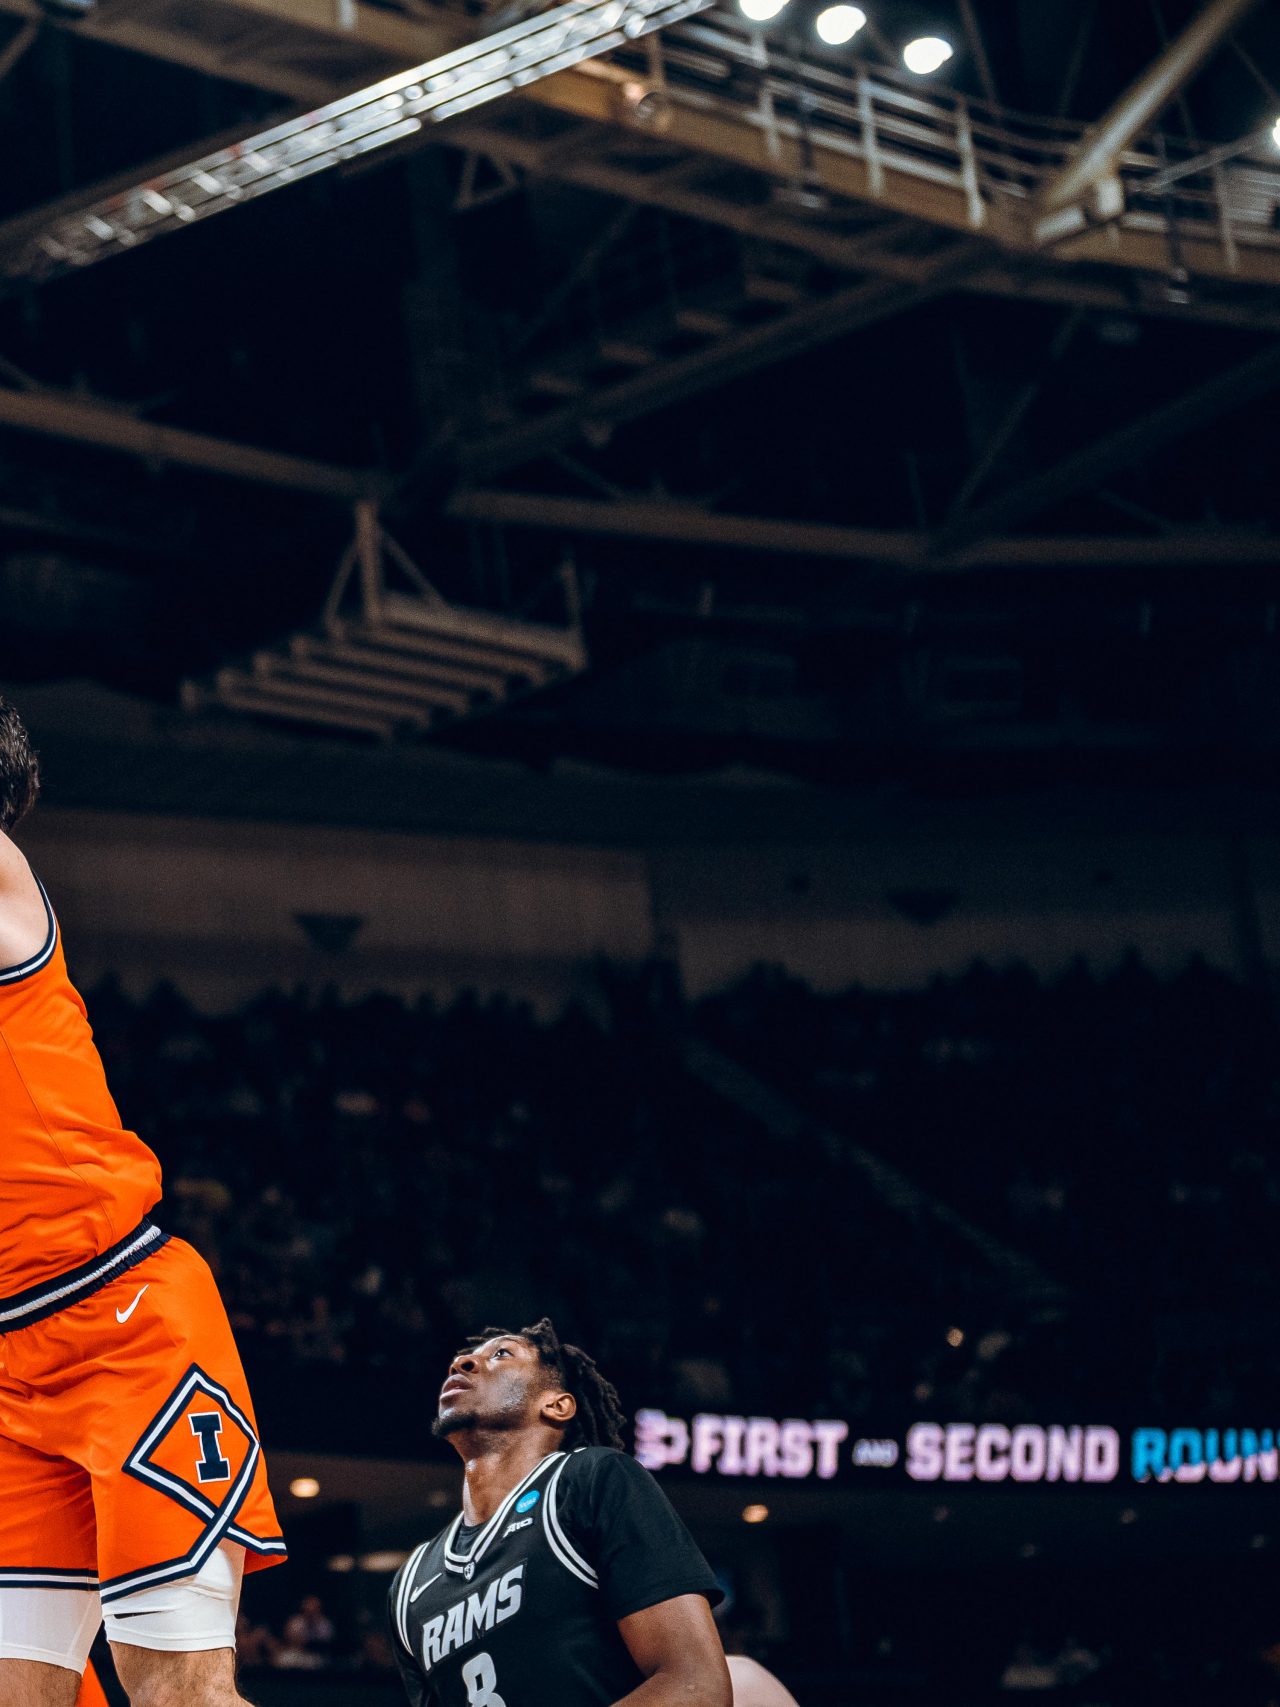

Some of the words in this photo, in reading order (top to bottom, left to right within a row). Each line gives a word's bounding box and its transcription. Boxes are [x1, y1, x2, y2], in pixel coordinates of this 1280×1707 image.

[187, 1411, 231, 1483] I
[691, 1412, 849, 1480] FIRST
[905, 1421, 1120, 1483] SECOND
[1131, 1427, 1280, 1483] ROUN
[422, 1564, 524, 1671] RAMS
